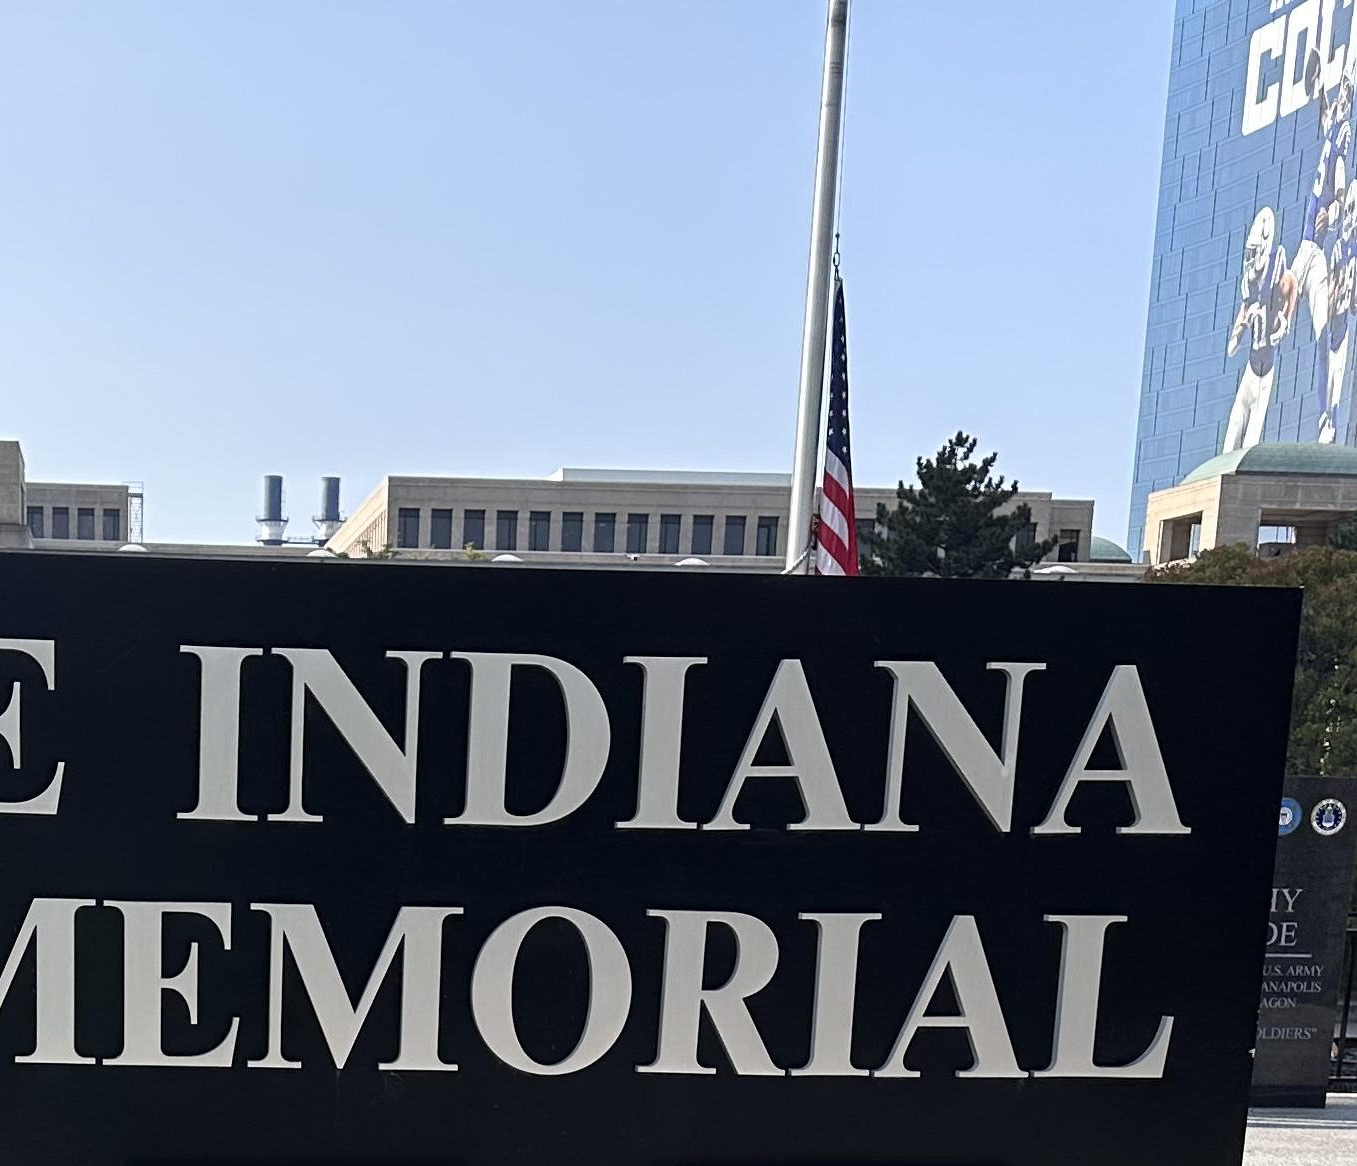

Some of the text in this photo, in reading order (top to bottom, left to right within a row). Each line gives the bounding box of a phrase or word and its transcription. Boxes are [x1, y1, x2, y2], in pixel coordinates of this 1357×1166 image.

[176, 644, 1192, 834] INDIANA
[1285, 964, 1325, 977] ARMY
[1261, 981, 1322, 993] ANAPOLIS
[1259, 997, 1297, 1009] AGON
